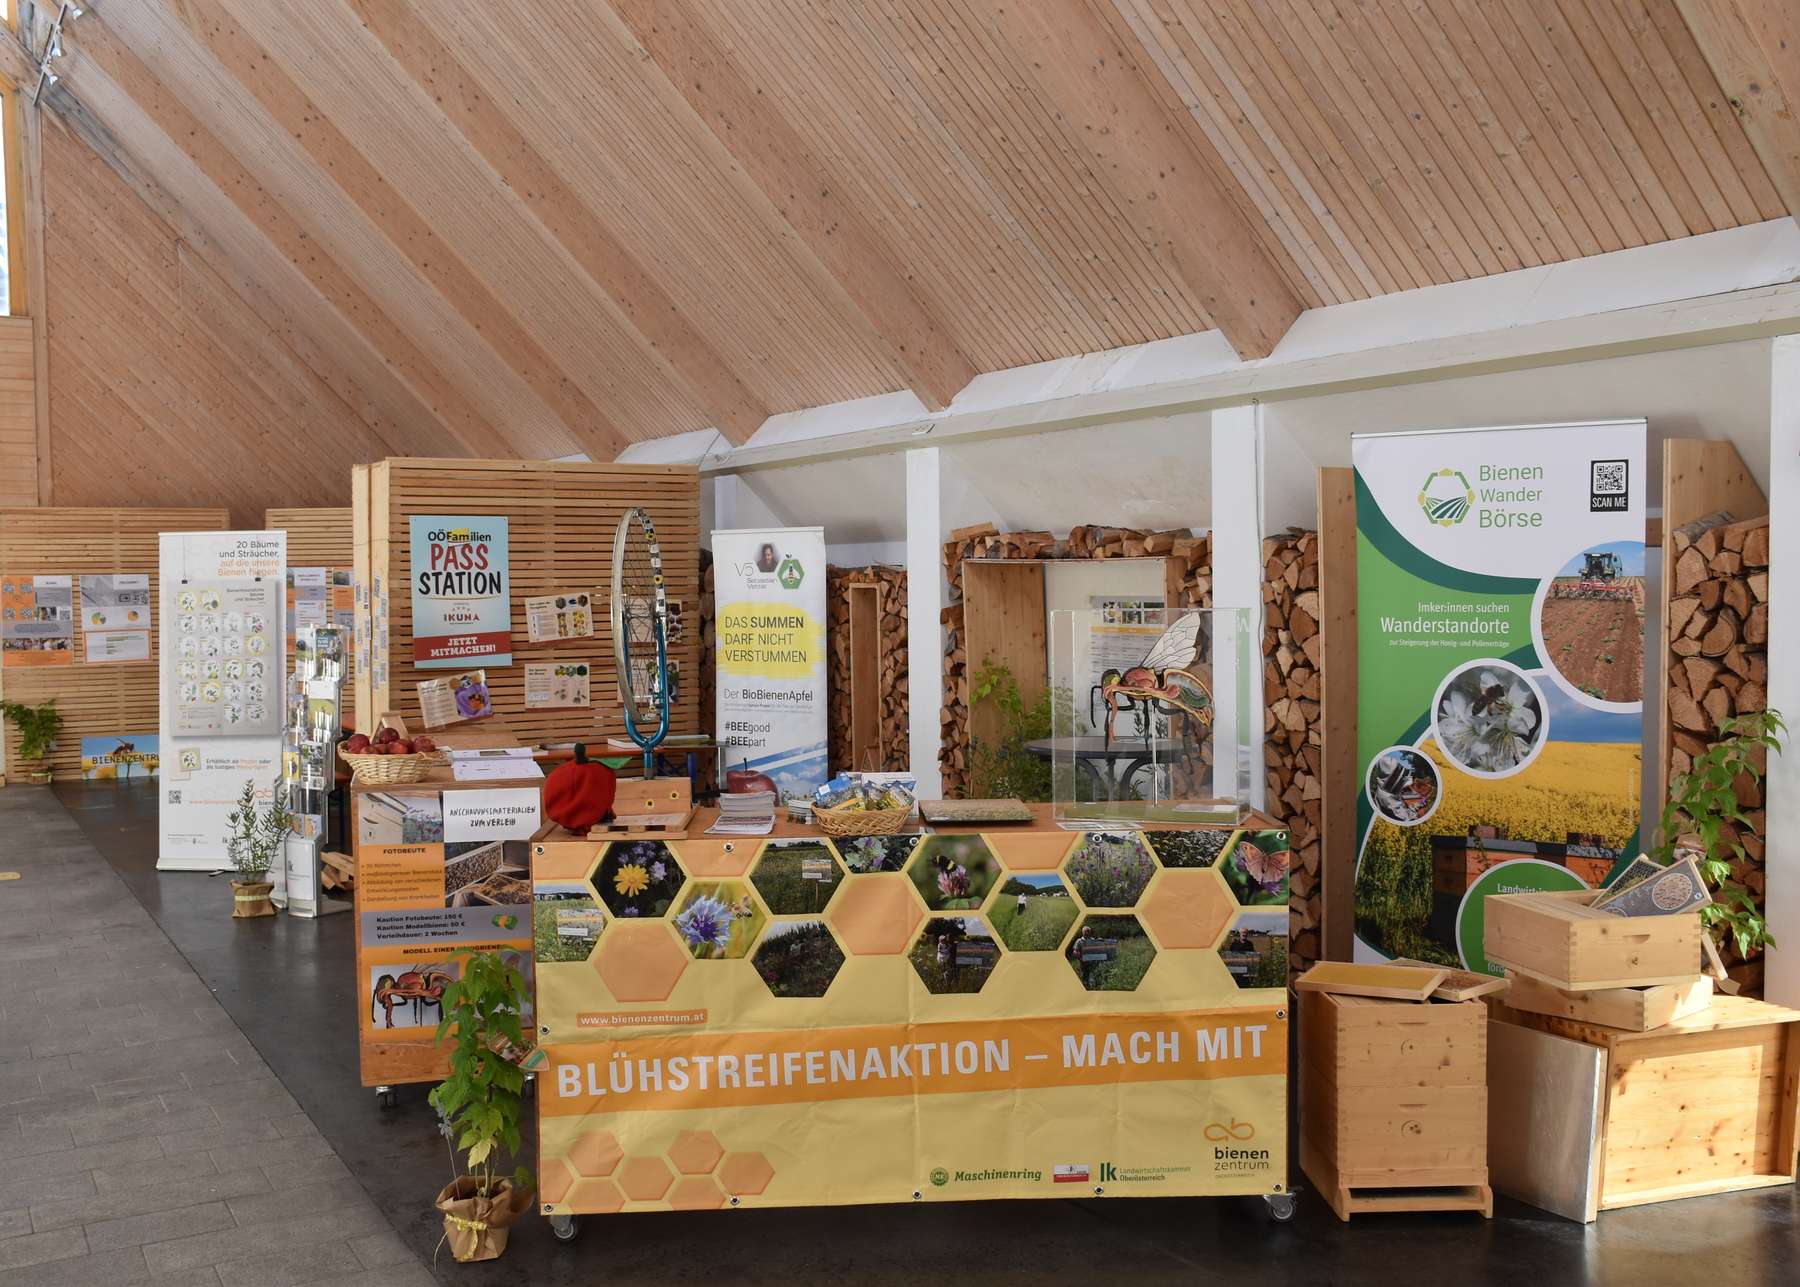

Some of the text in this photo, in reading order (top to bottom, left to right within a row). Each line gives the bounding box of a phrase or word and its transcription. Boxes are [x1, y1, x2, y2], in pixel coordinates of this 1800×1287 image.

[1479, 465, 1544, 482] Bienen
[1479, 488, 1543, 503] Wander
[1592, 496, 1627, 508] SCAN ME
[1479, 509, 1543, 528] Börse
[427, 528, 492, 542] OÖFamilien
[236, 540, 280, 549] 20 Bäume
[219, 550, 235, 558] und
[430, 543, 489, 571] PASS
[418, 570, 501, 596] STATION
[1418, 602, 1510, 613] Imker:innen suchen
[443, 613, 481, 622] IKUNA
[725, 616, 804, 628] DAS SUMMEN
[1380, 617, 1510, 634] Wanderstandorte
[447, 637, 477, 646] JETZT
[725, 633, 794, 645] DARF NICHT
[430, 645, 497, 657] MITMACHEN!
[725, 650, 807, 663] VERSTUMMEN
[723, 688, 813, 703] Der BioBienenApfel
[725, 721, 771, 734] #BEEgood
[725, 736, 767, 748] #BEEpart
[91, 754, 160, 764] BIENENZENTRU
[470, 818, 516, 828] ZUM VERLEIH
[580, 1013, 705, 1025] www.bienenzentrum.at
[557, 1038, 1010, 1098] BLÜHSTREIFENAKTION
[1062, 1031, 1180, 1068] MACH
[1196, 1025, 1268, 1063] MIT
[1214, 1147, 1269, 1159] bienen
[1214, 1159, 1269, 1171] zentrum
[954, 1168, 1042, 1182] Maschinenring
